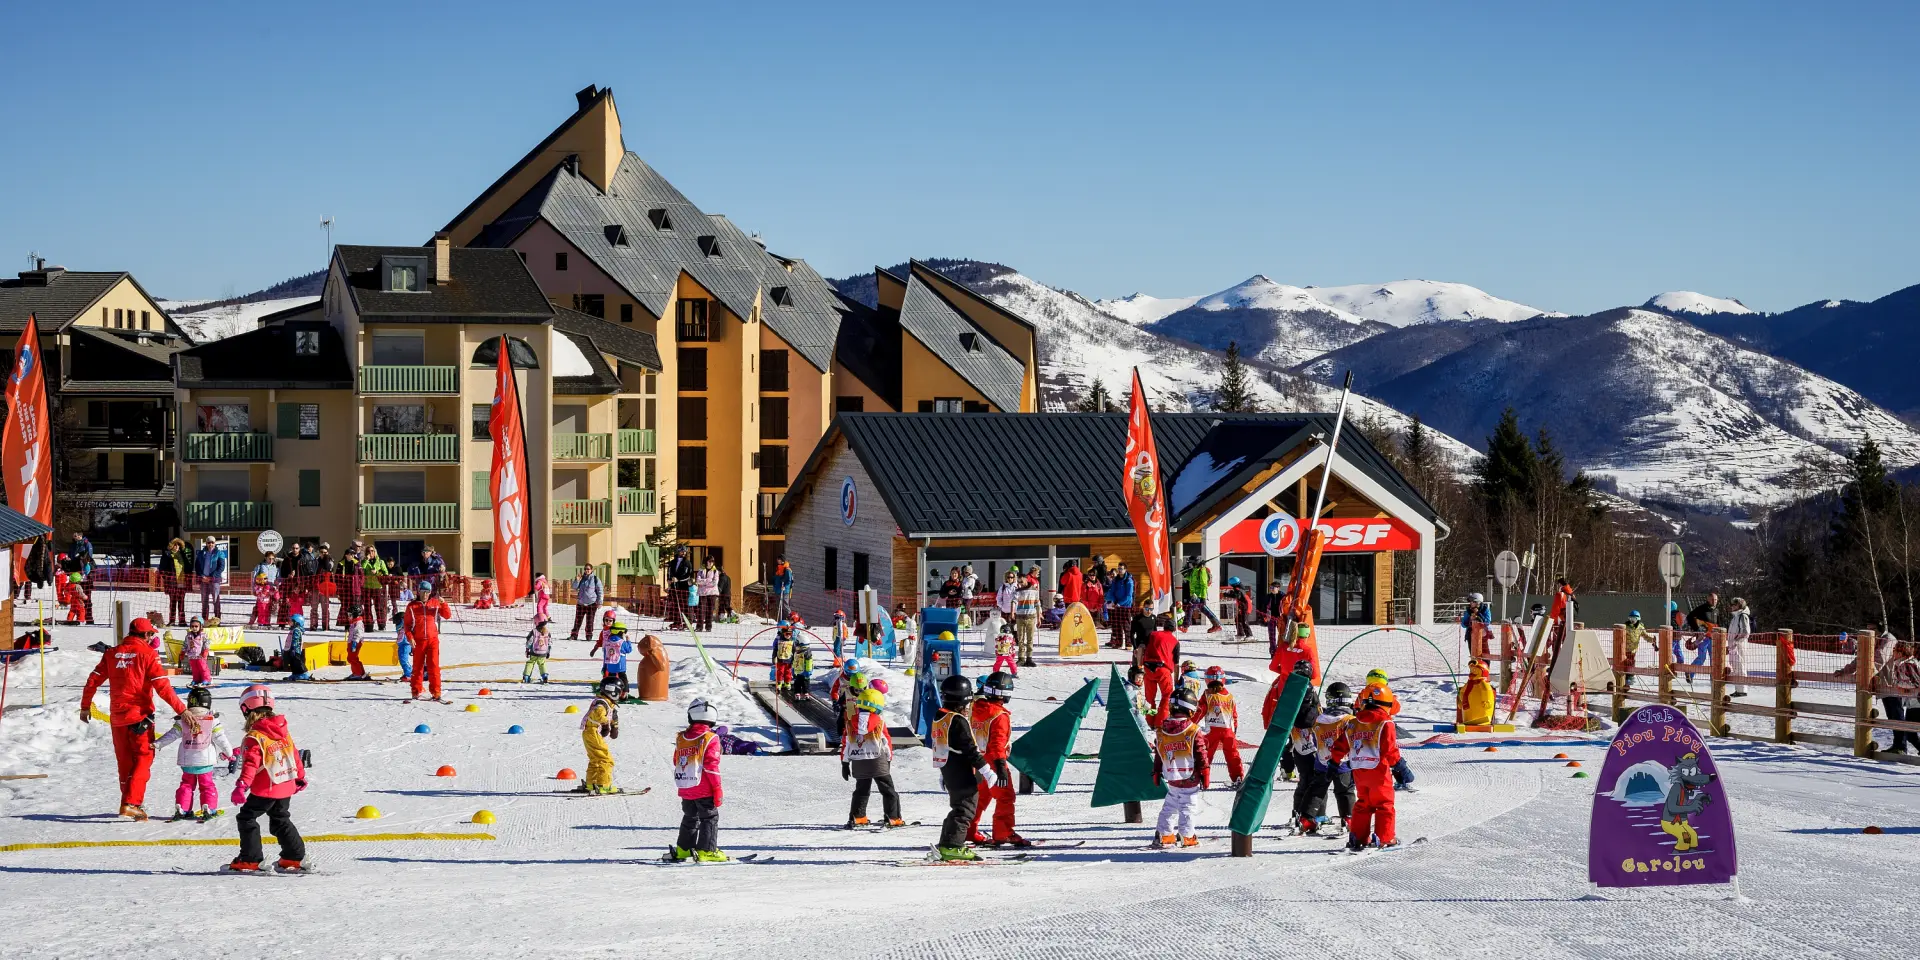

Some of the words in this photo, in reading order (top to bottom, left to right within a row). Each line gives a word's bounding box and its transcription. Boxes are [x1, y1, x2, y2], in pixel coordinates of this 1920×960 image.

[108, 501, 133, 509] SPORTS
[116, 660, 127, 668] AX
[1637, 709, 1673, 723] Club
[1612, 729, 1655, 756] Piou
[1662, 725, 1702, 753] Piou
[1302, 742, 1310, 751] AX
[1622, 856, 1705, 873] Garolou
